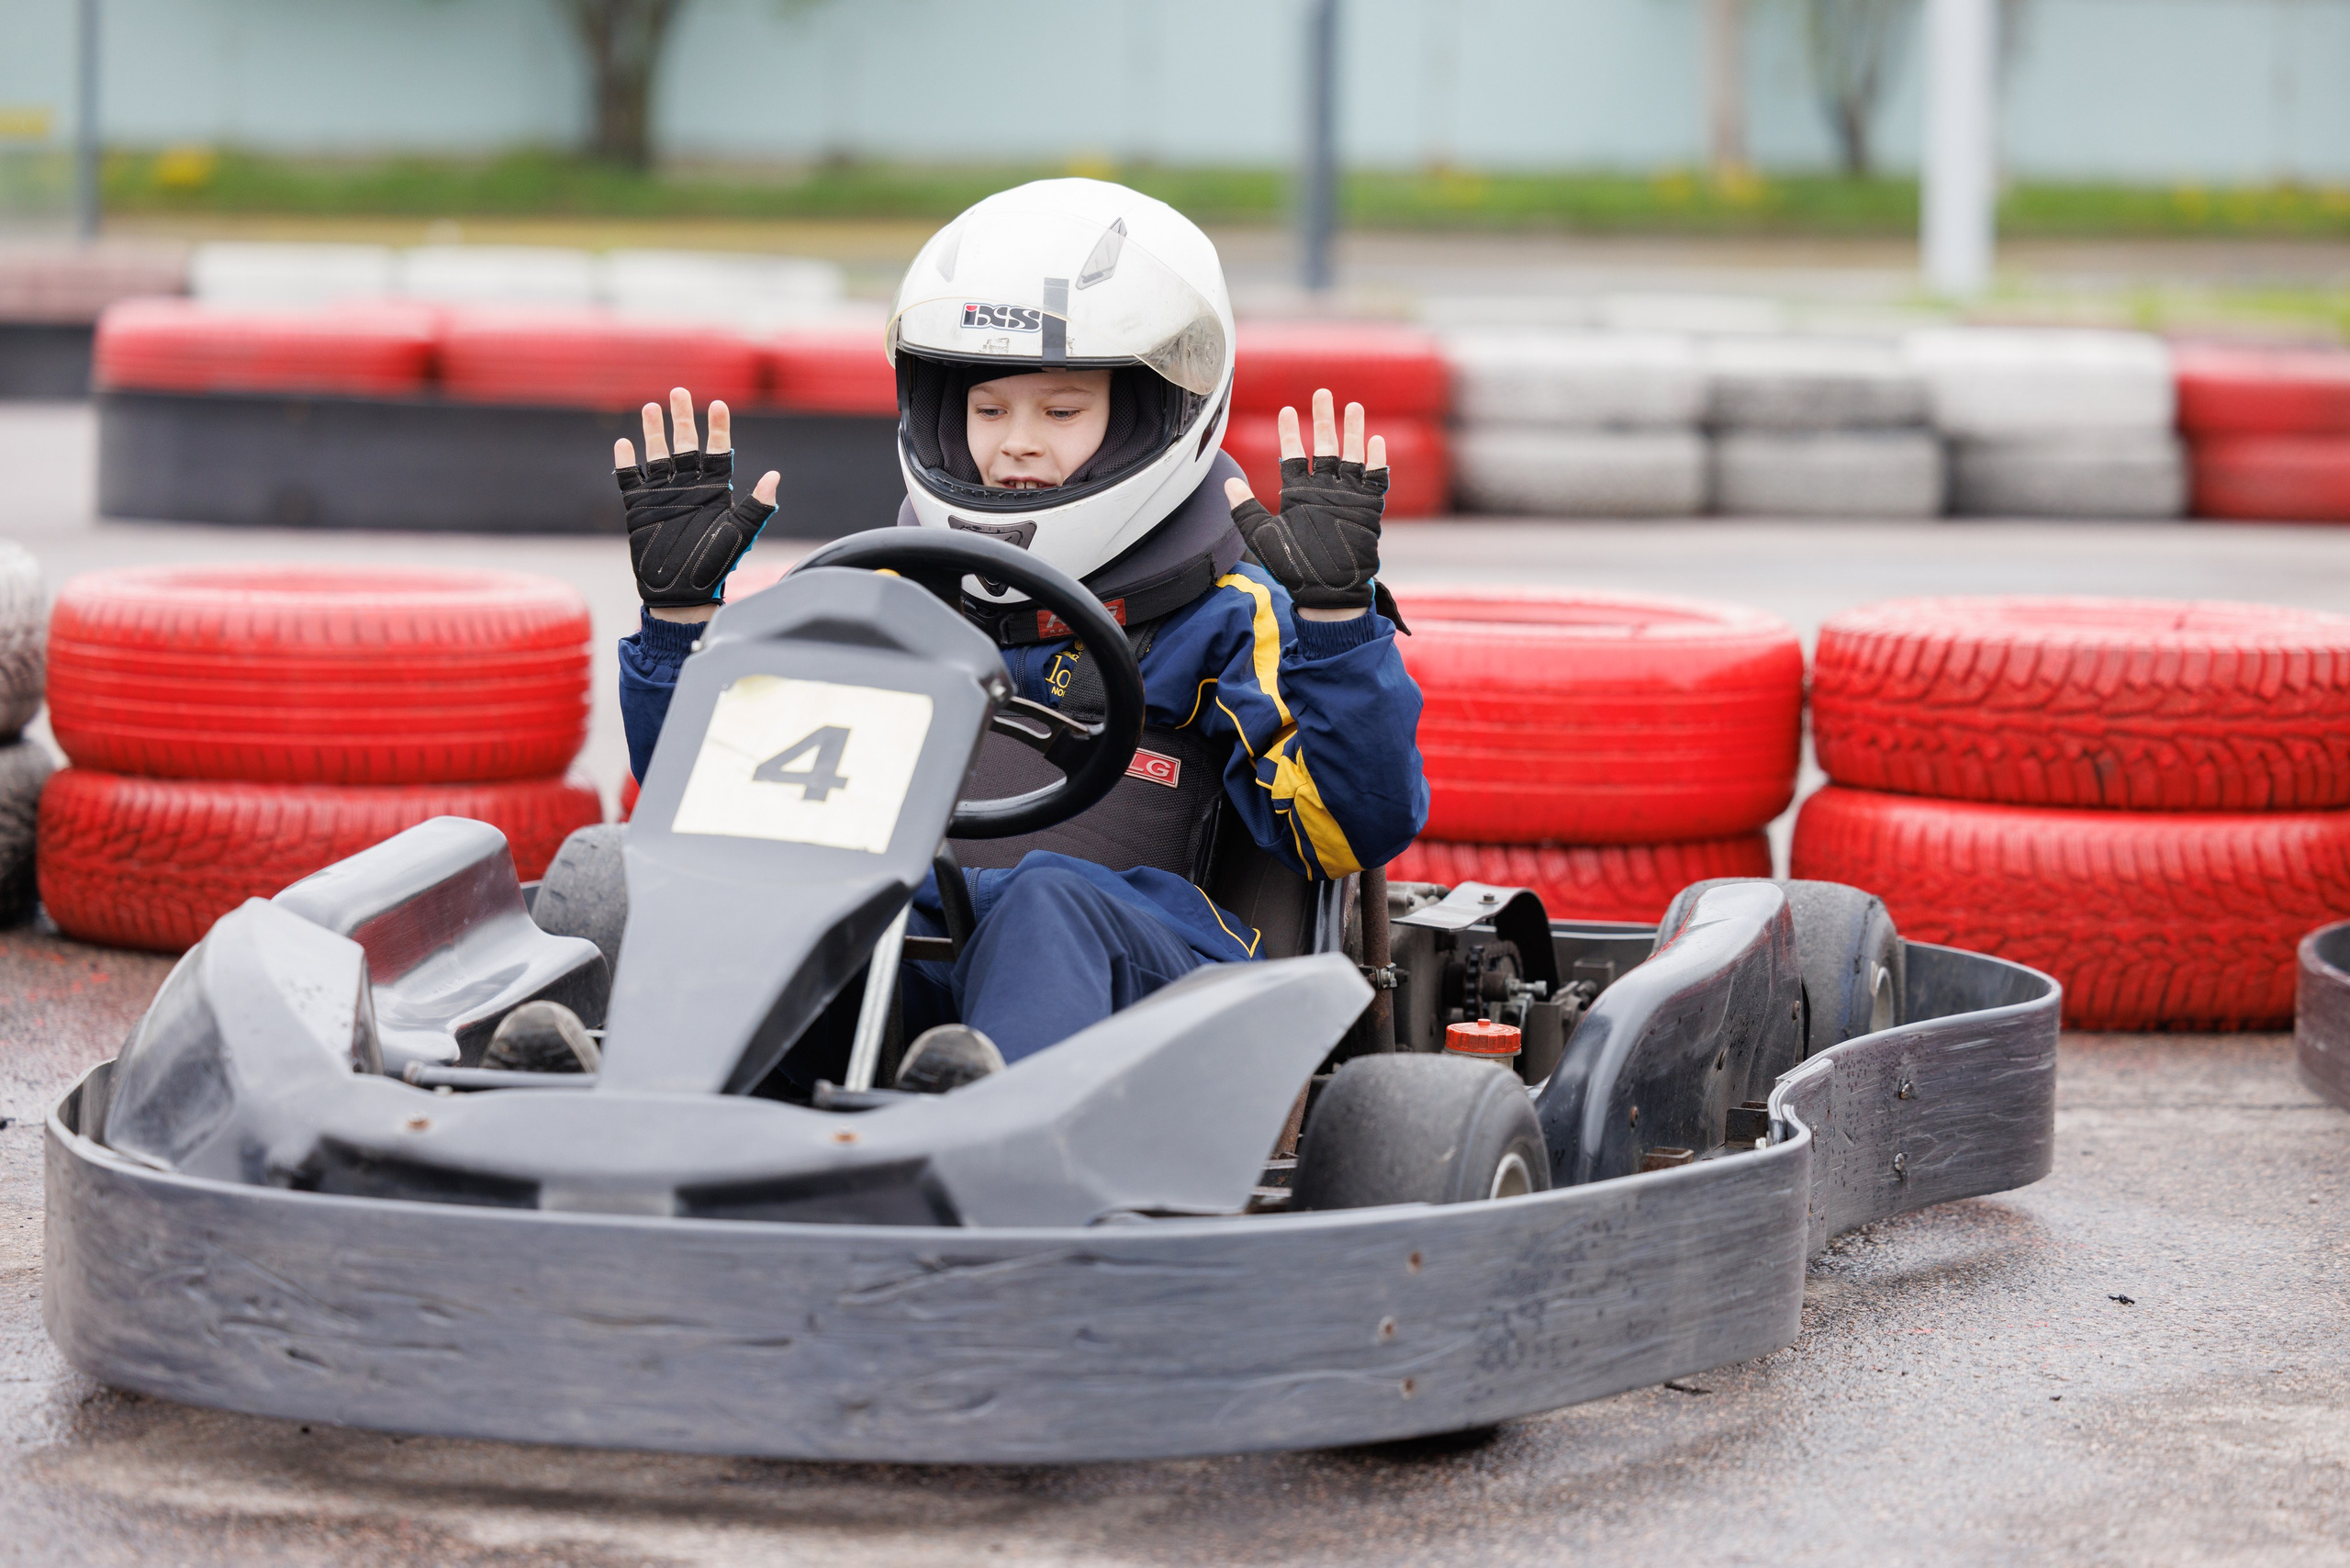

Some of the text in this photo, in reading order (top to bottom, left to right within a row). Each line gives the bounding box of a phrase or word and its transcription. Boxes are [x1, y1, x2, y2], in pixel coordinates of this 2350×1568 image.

[1051, 686, 1066, 698] NO
[752, 724, 852, 802] 4
[1128, 754, 1171, 778] LG
